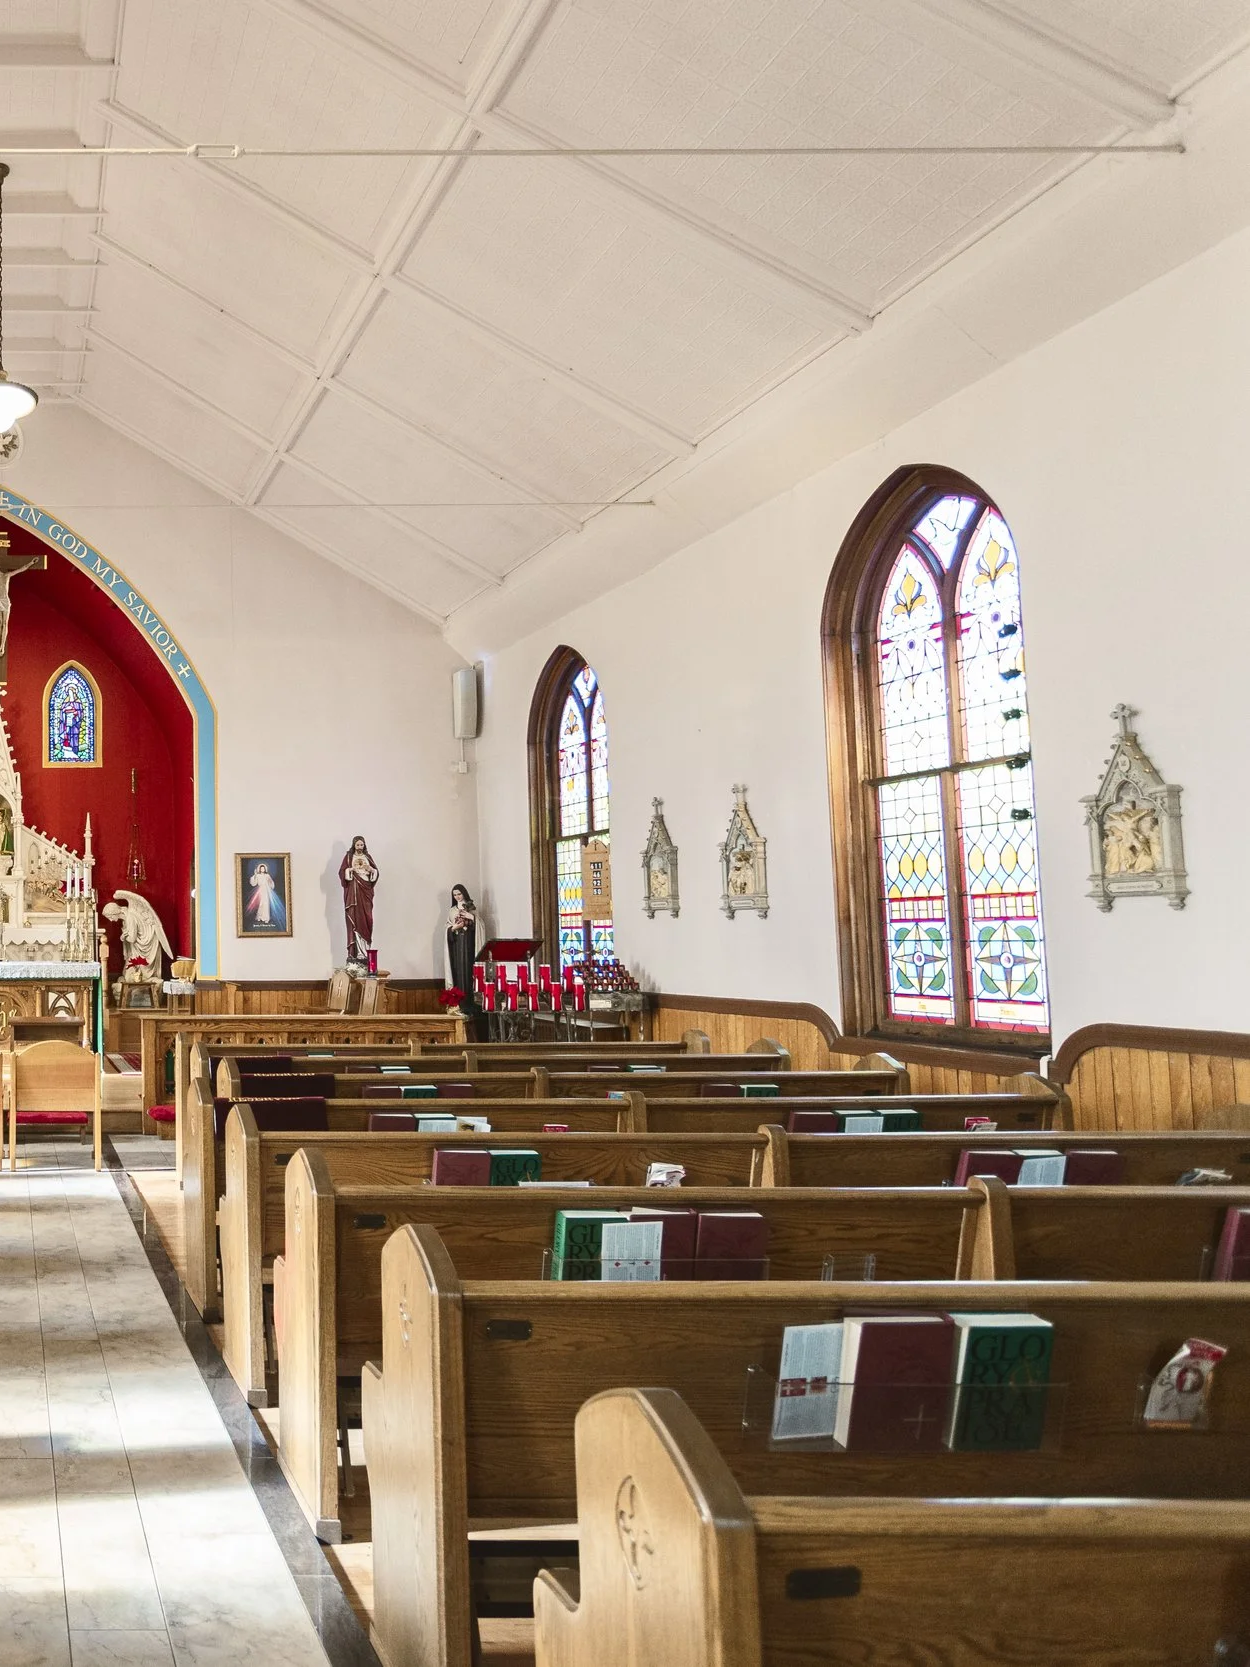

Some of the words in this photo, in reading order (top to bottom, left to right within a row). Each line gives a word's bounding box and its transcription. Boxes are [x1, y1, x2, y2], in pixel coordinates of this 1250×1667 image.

[18, 503, 43, 526] IN
[48, 524, 88, 559] GOD
[90, 557, 123, 589] MY
[123, 592, 178, 660] SAVIOR
[496, 1158, 538, 1174] GLO
[568, 1224, 602, 1245] GL
[972, 1333, 1046, 1361] GLO
[969, 1361, 1015, 1387] RY
